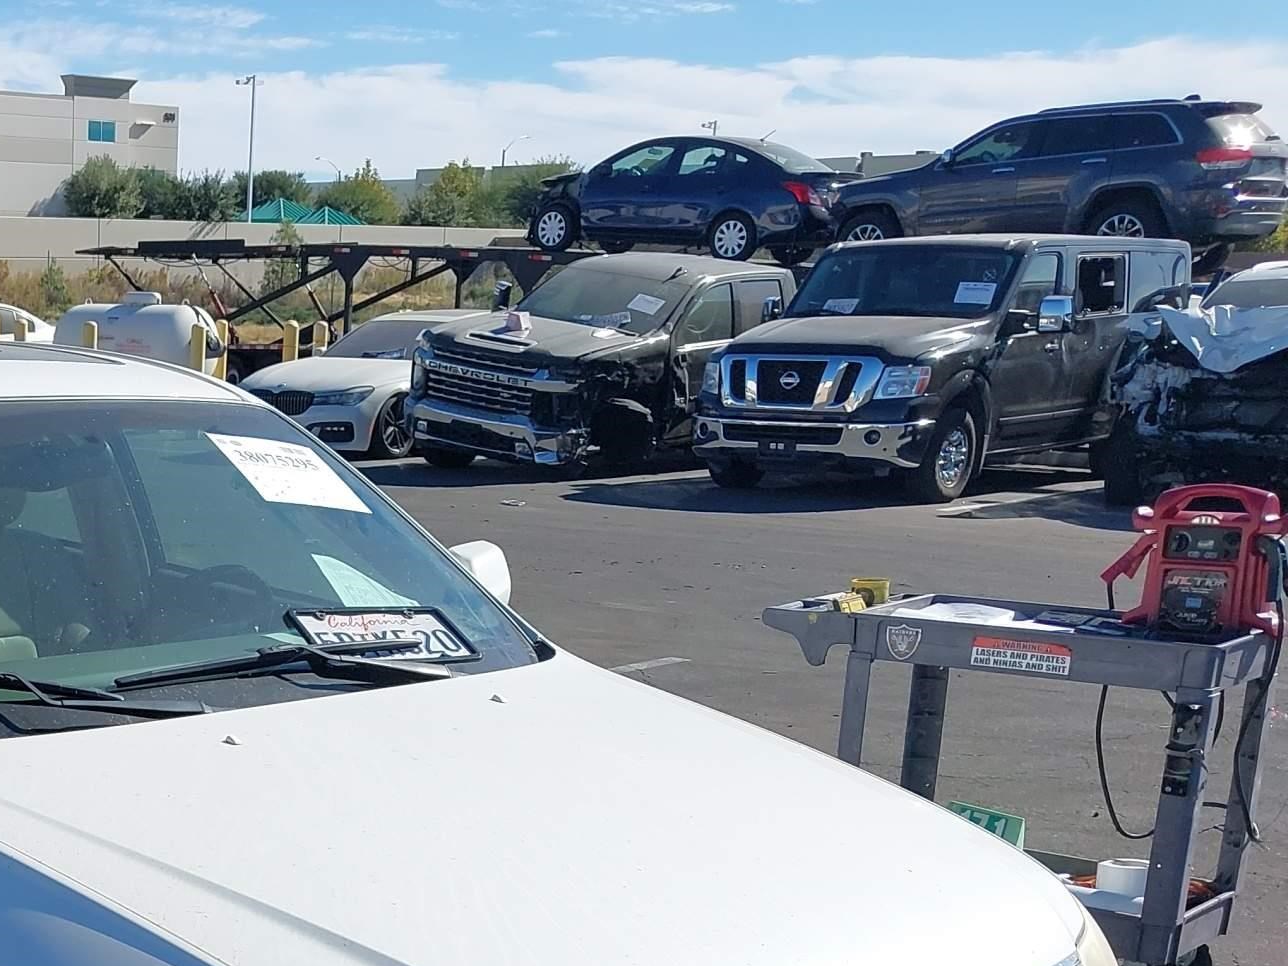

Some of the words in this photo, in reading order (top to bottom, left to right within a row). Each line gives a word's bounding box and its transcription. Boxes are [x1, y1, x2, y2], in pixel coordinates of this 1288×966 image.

[428, 361, 531, 388] CHEVROLET
[234, 449, 320, 471] 38075295
[328, 613, 416, 631] California
[1001, 640, 1044, 652] WARNING
[973, 656, 991, 666] AND
[993, 658, 1023, 669] NINJAS
[1025, 661, 1044, 671] AND
[1045, 664, 1067, 674] SHIT
[975, 648, 1009, 659] LASERS
[1009, 651, 1028, 661] AND
[1030, 653, 1067, 665] PIRATES
